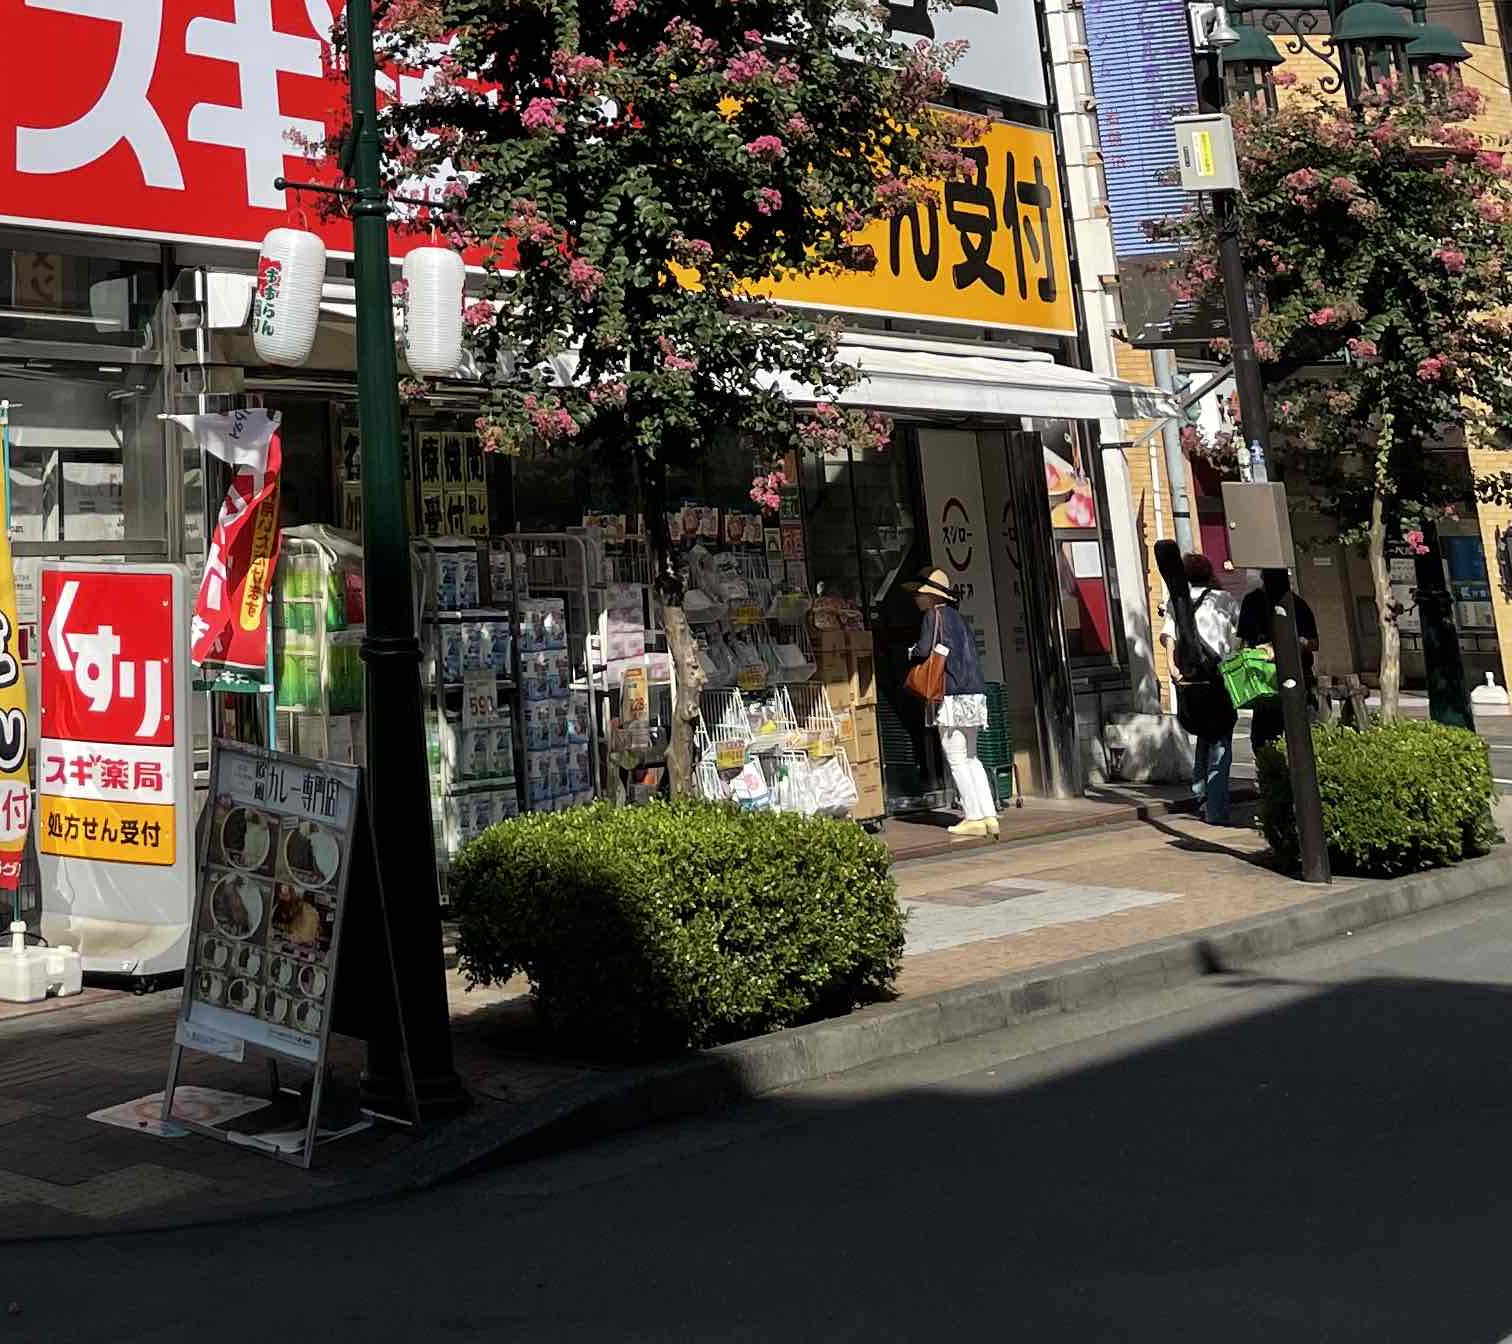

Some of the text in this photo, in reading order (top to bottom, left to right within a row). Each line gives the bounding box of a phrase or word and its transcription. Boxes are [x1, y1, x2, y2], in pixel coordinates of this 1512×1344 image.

[941, 525, 973, 545] スシロー
[48, 580, 162, 738] くすり
[44, 753, 165, 793] スギ薬局
[47, 809, 162, 848] 処方せん受付
